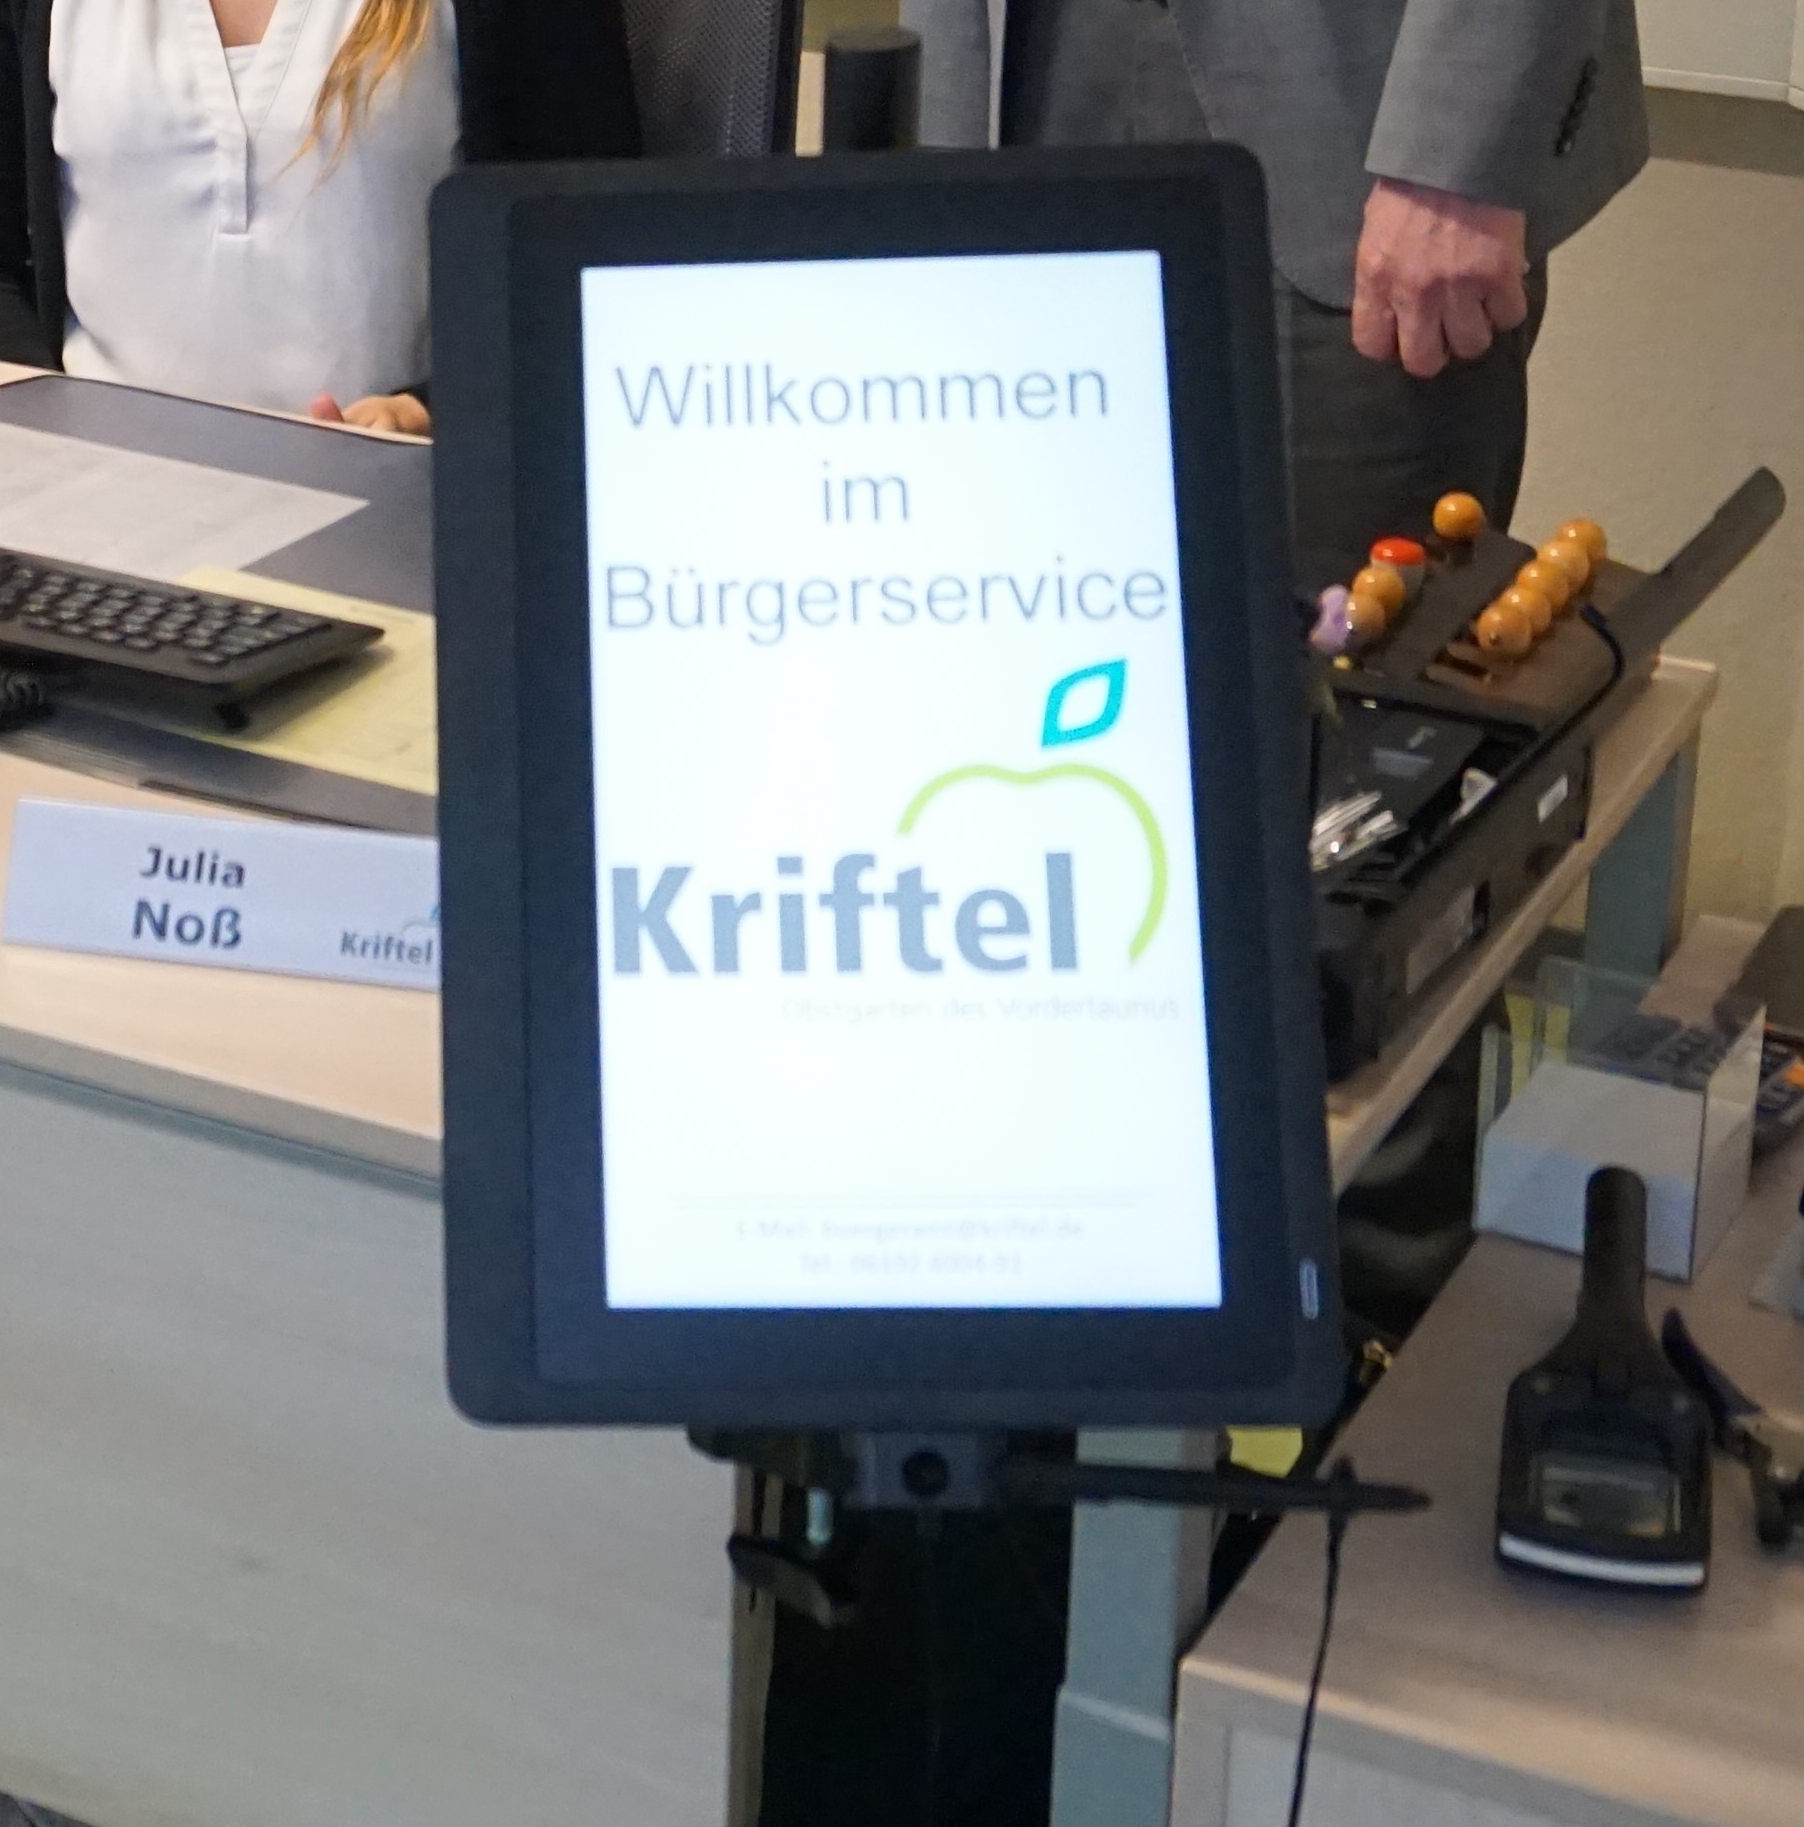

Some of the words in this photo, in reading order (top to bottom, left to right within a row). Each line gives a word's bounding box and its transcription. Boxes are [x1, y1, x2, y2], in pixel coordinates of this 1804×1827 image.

[615, 363, 1109, 429] Willkommen
[822, 461, 910, 524] im
[605, 554, 1168, 646] Bürgerservice
[138, 845, 247, 889] Julia
[132, 899, 243, 950] Noß
[609, 851, 1080, 978] Kriftel
[339, 930, 434, 966] Kriftel
